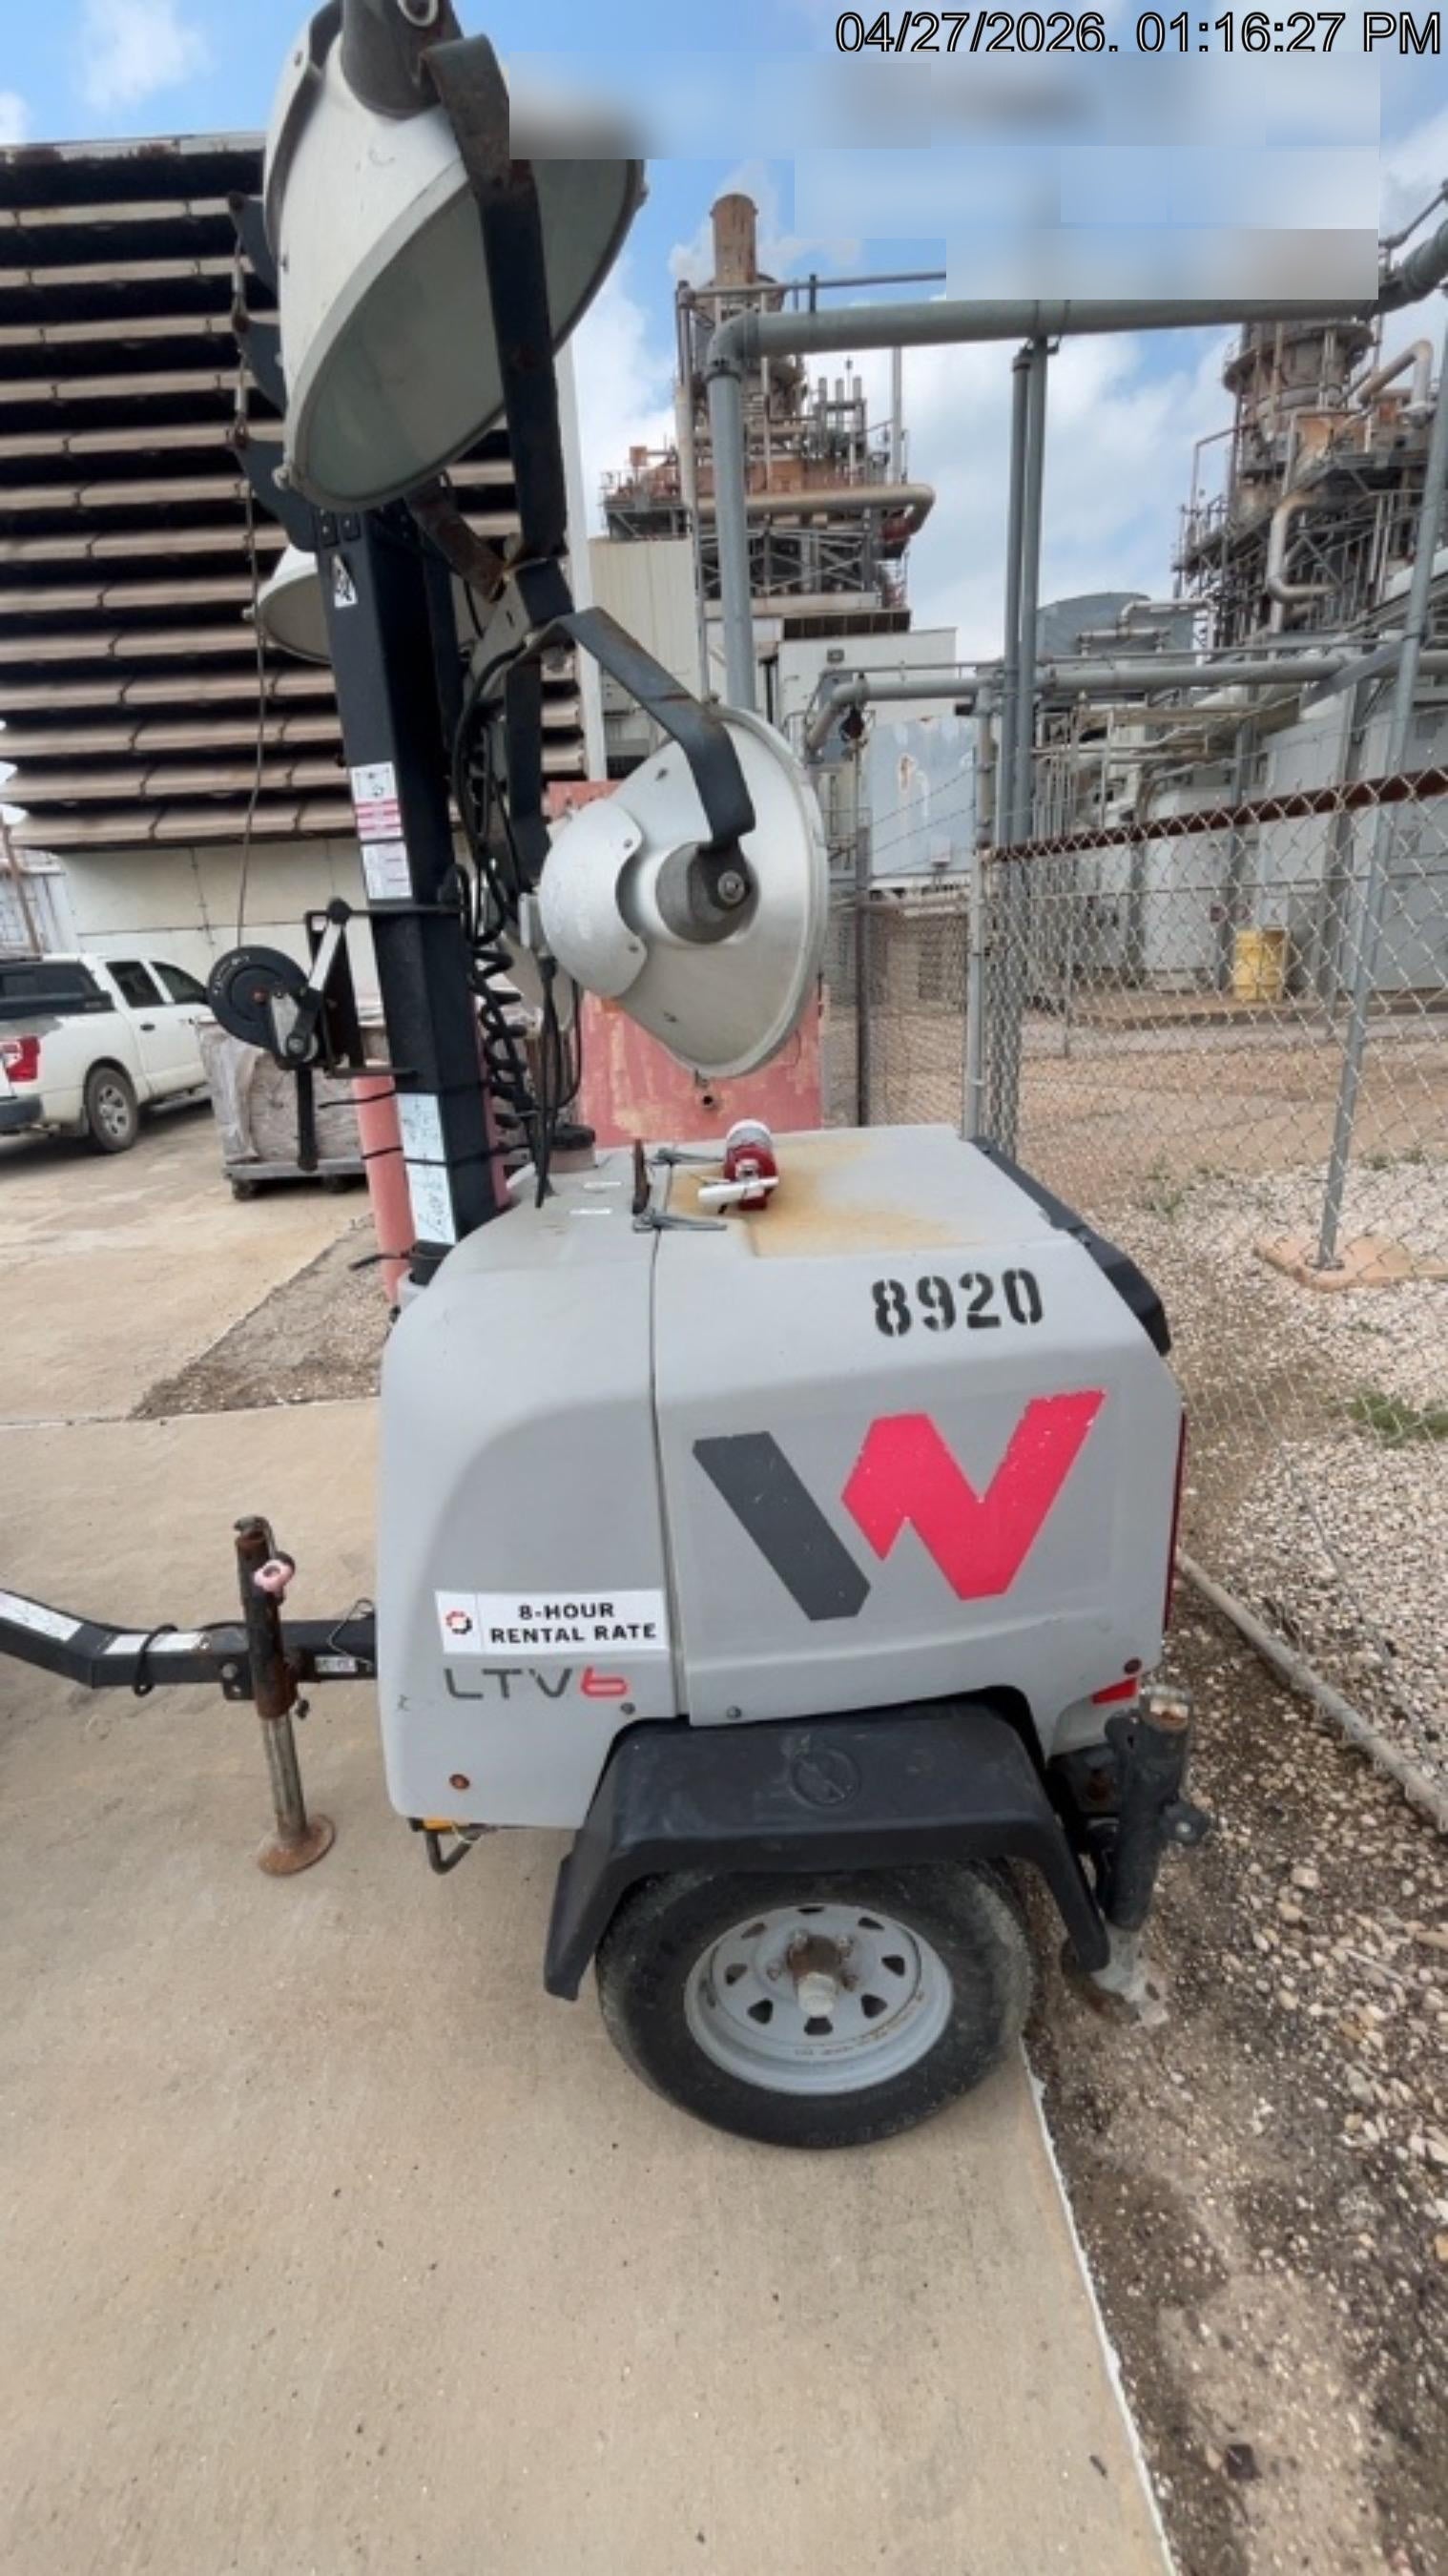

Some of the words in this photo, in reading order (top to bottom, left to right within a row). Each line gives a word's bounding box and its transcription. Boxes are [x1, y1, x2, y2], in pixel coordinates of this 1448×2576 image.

[871, 1268, 1045, 1337] 8920
[518, 1602, 615, 1620] 8-HOUR
[489, 1628, 585, 1644] RENTAL
[594, 1623, 657, 1640] RATE
[444, 1666, 629, 1701] LTV6
